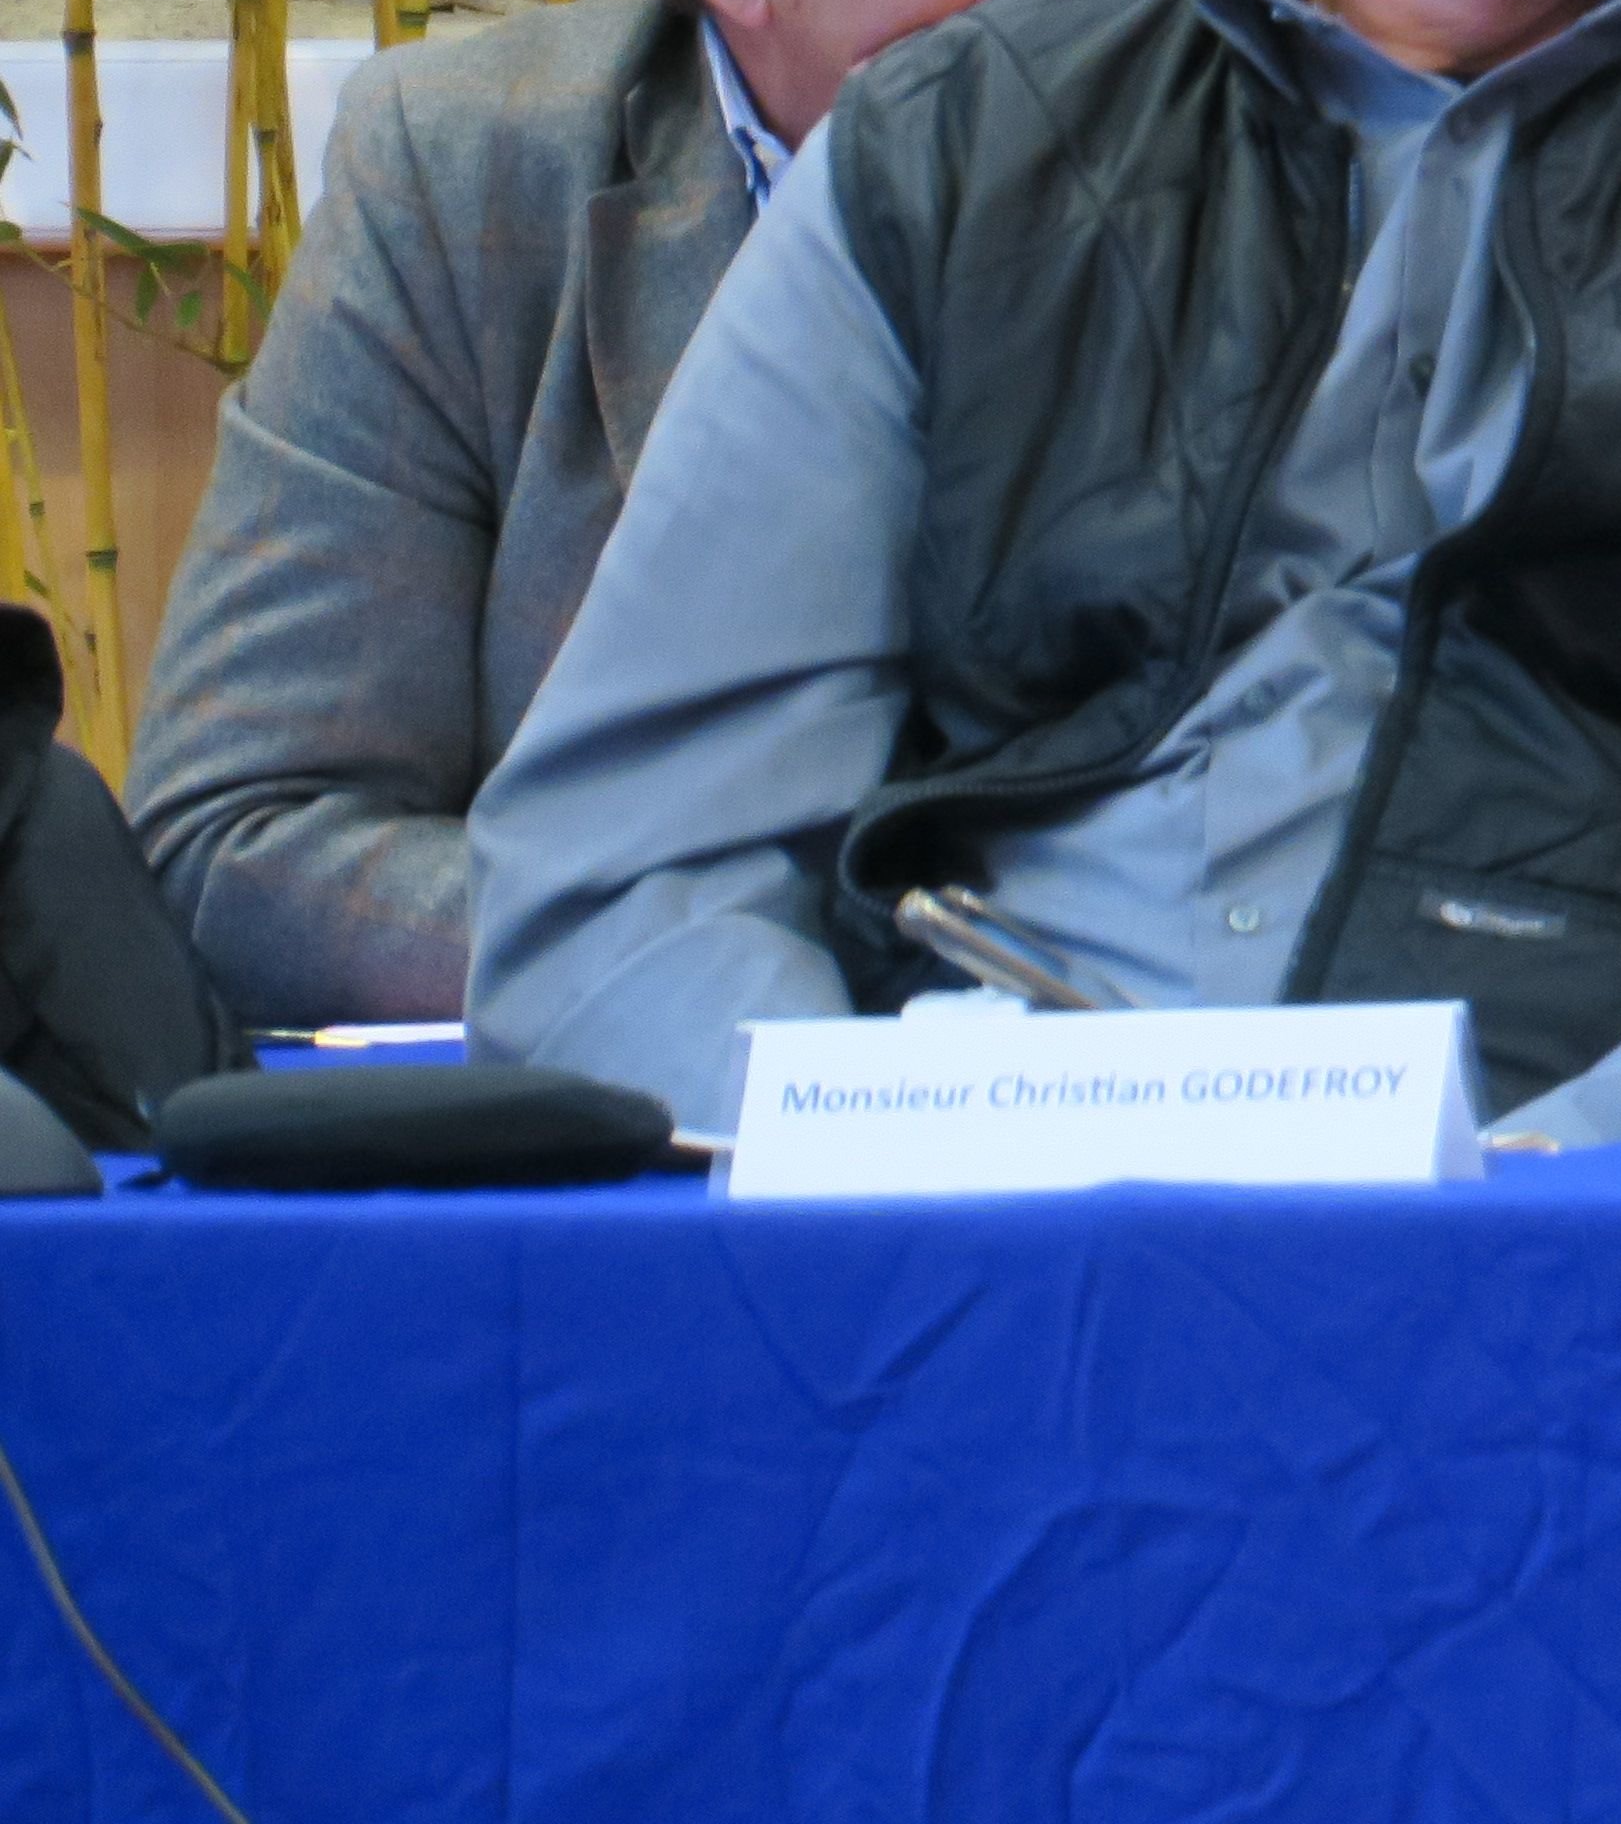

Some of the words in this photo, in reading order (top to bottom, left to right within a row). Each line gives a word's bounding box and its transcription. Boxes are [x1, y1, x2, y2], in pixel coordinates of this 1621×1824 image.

[781, 1077, 975, 1114] Monsieur
[988, 1072, 1167, 1109] Christian
[1180, 1064, 1410, 1104] GODEFROY
